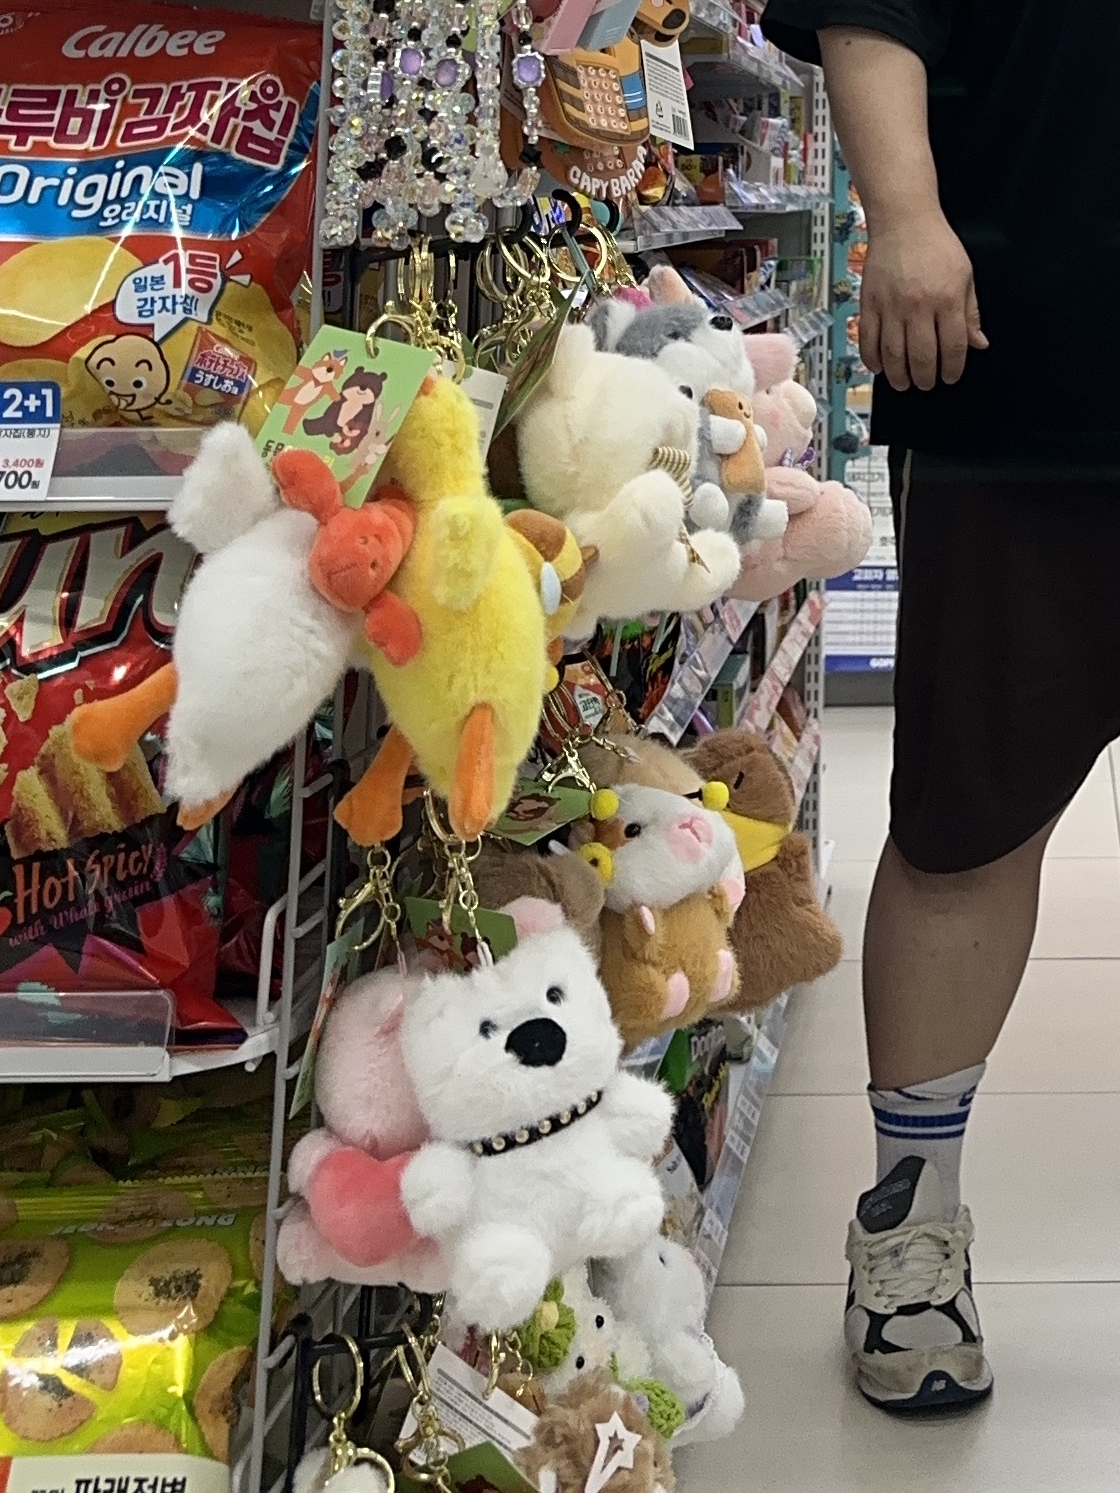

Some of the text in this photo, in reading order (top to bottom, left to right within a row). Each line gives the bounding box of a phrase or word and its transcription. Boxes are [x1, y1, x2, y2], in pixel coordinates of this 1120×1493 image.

[62, 24, 226, 59] Calbee
[0, 73, 300, 170] 루비 감자칩
[0, 160, 203, 218] Original
[99, 200, 193, 227] 오리지널
[132, 250, 220, 294] 일본 1등
[136, 293, 199, 318] 감자칩!
[2, 388, 54, 418] 2+1
[0, 428, 51, 439] 자칩(봉지)
[13, 843, 153, 924] Hot Spicy
